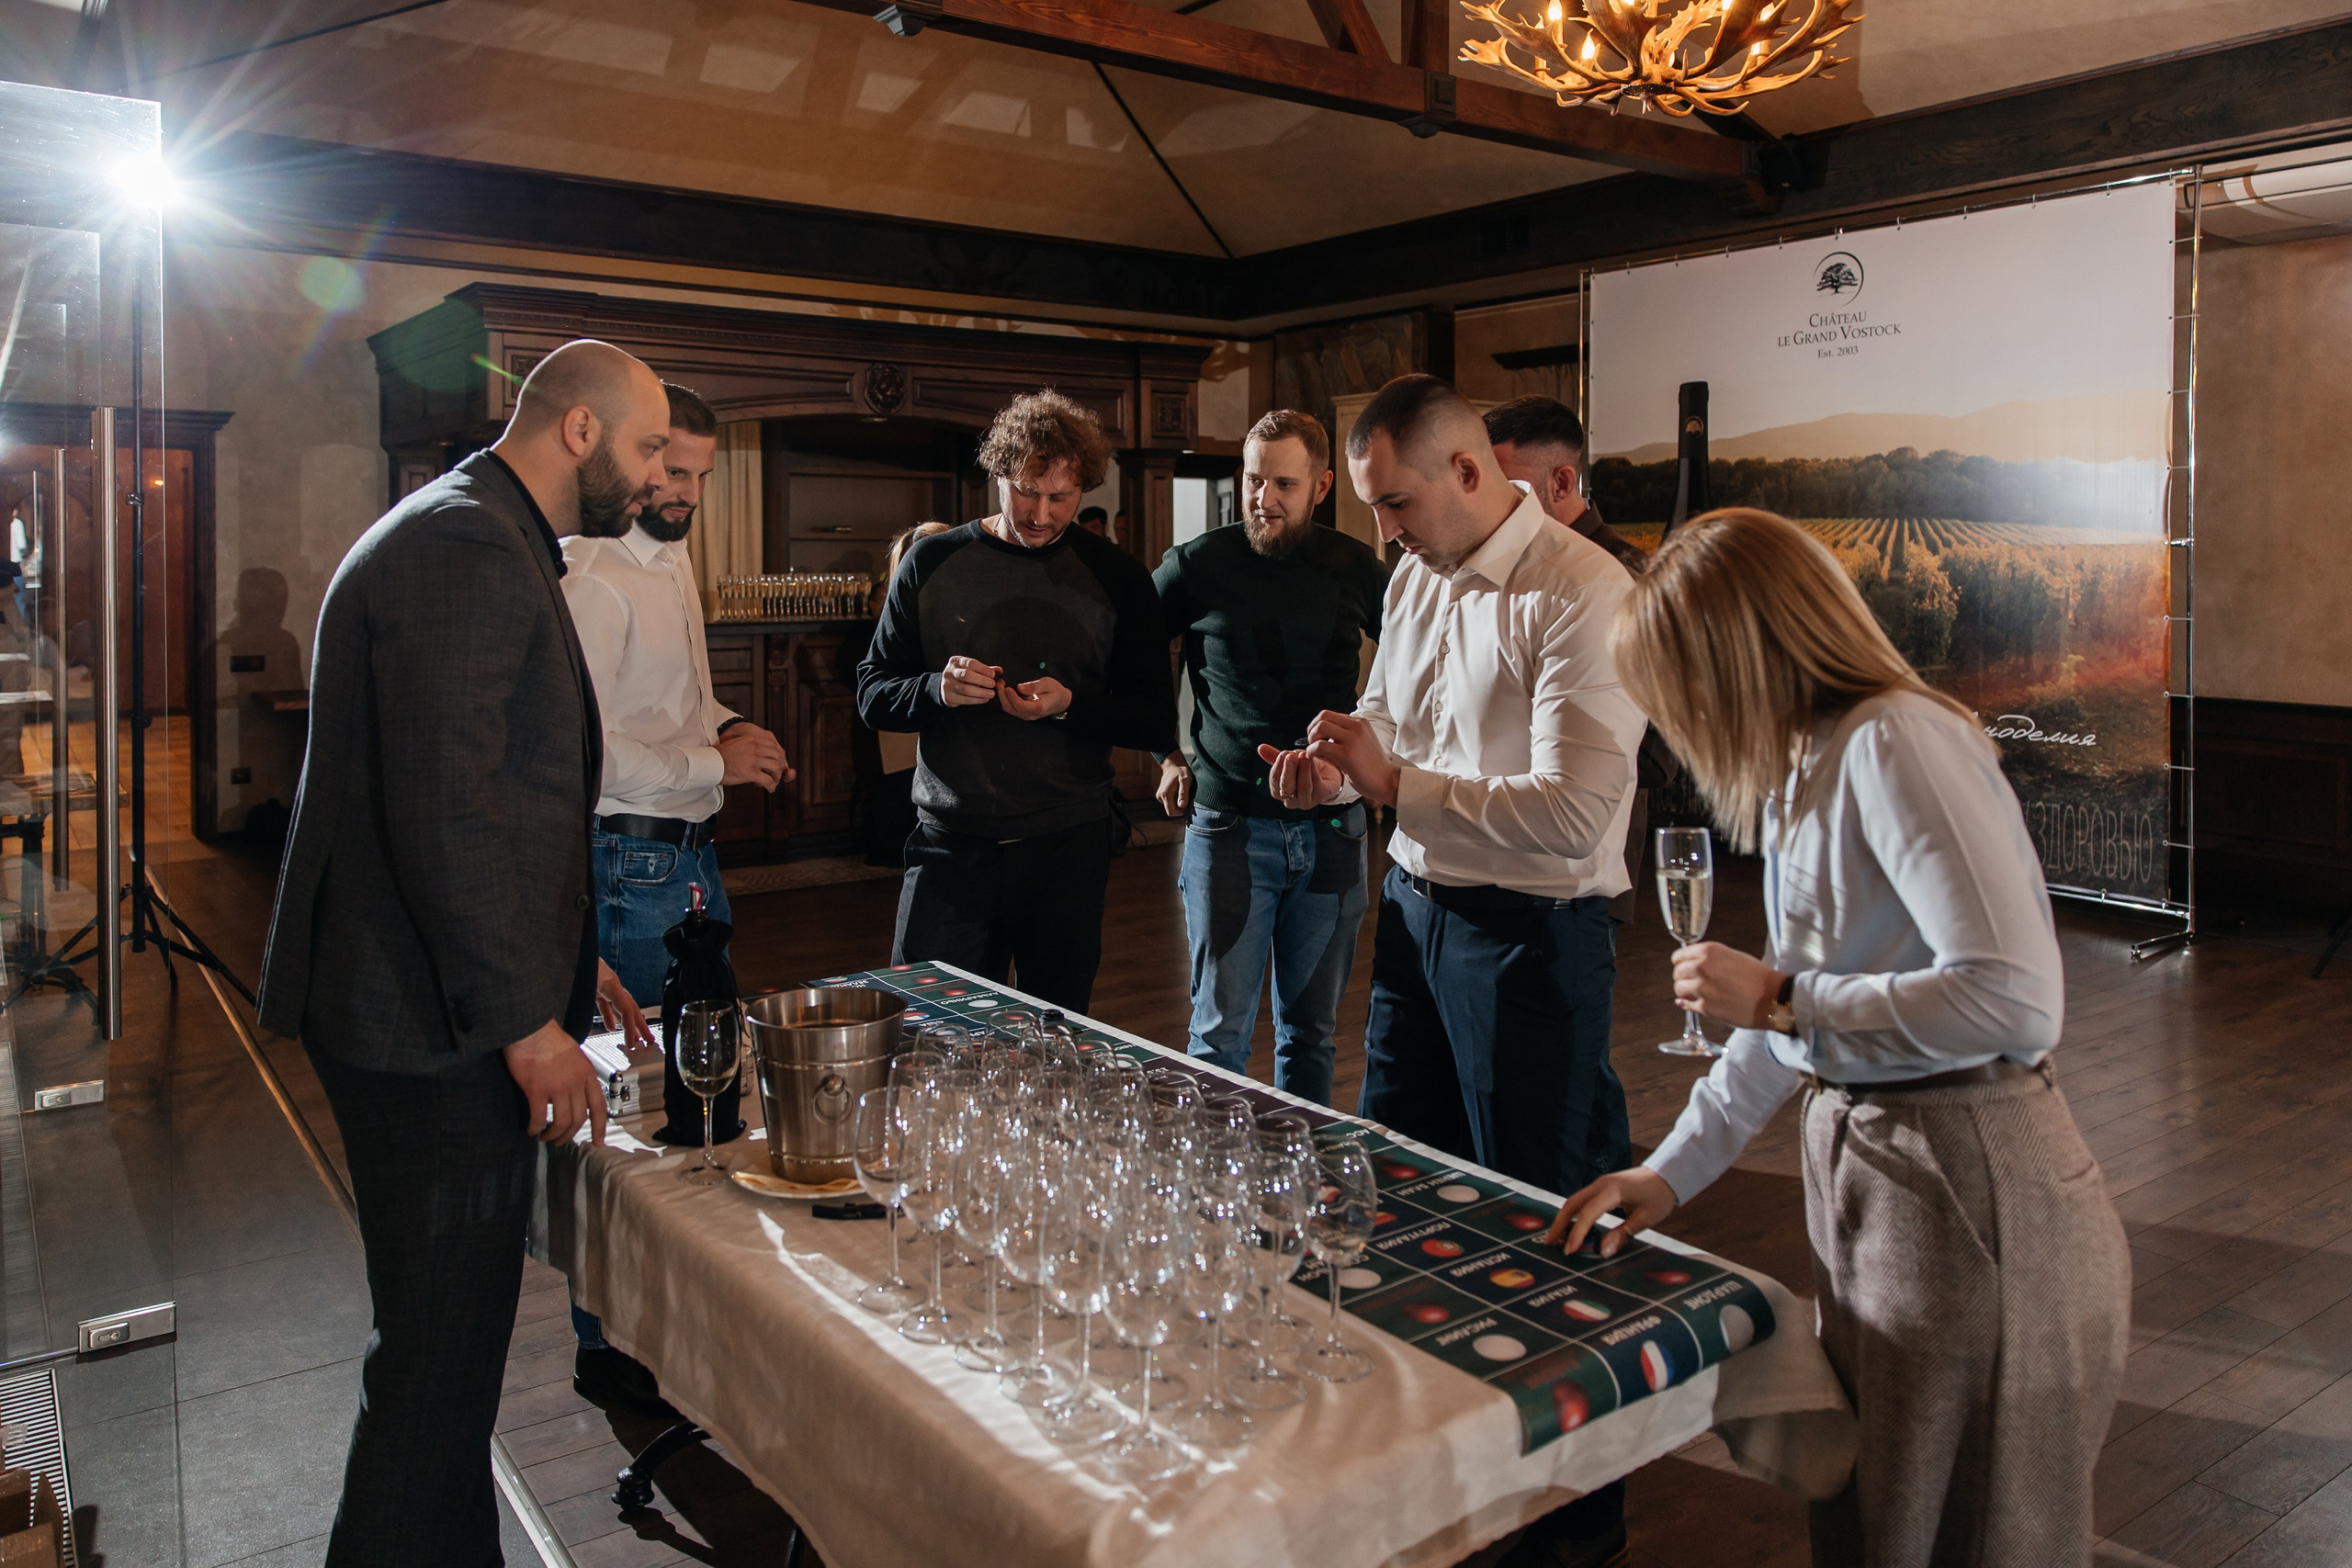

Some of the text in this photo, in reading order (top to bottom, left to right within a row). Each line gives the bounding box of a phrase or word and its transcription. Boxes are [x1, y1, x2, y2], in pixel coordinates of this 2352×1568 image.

[1809, 310, 1867, 328] CHÂTEAU
[1793, 330, 1838, 345] GRAND
[1840, 323, 1902, 340] VOSTOCK
[1817, 345, 1859, 358] Est. 2003
[940, 991, 999, 1006] АЛЬБАРИНЬО
[1376, 1221, 1452, 1251] ПОРТУГАЛИЯ
[1449, 1251, 1512, 1278] ИСПАНИЯ
[1526, 1284, 1578, 1308] ИТАЛИЯ
[1682, 1280, 1744, 1311] ШАРДОНЕ
[1435, 1317, 1498, 1348] РИСЛИНГ
[1600, 1314, 1662, 1346] ФРАНЦИЯ
